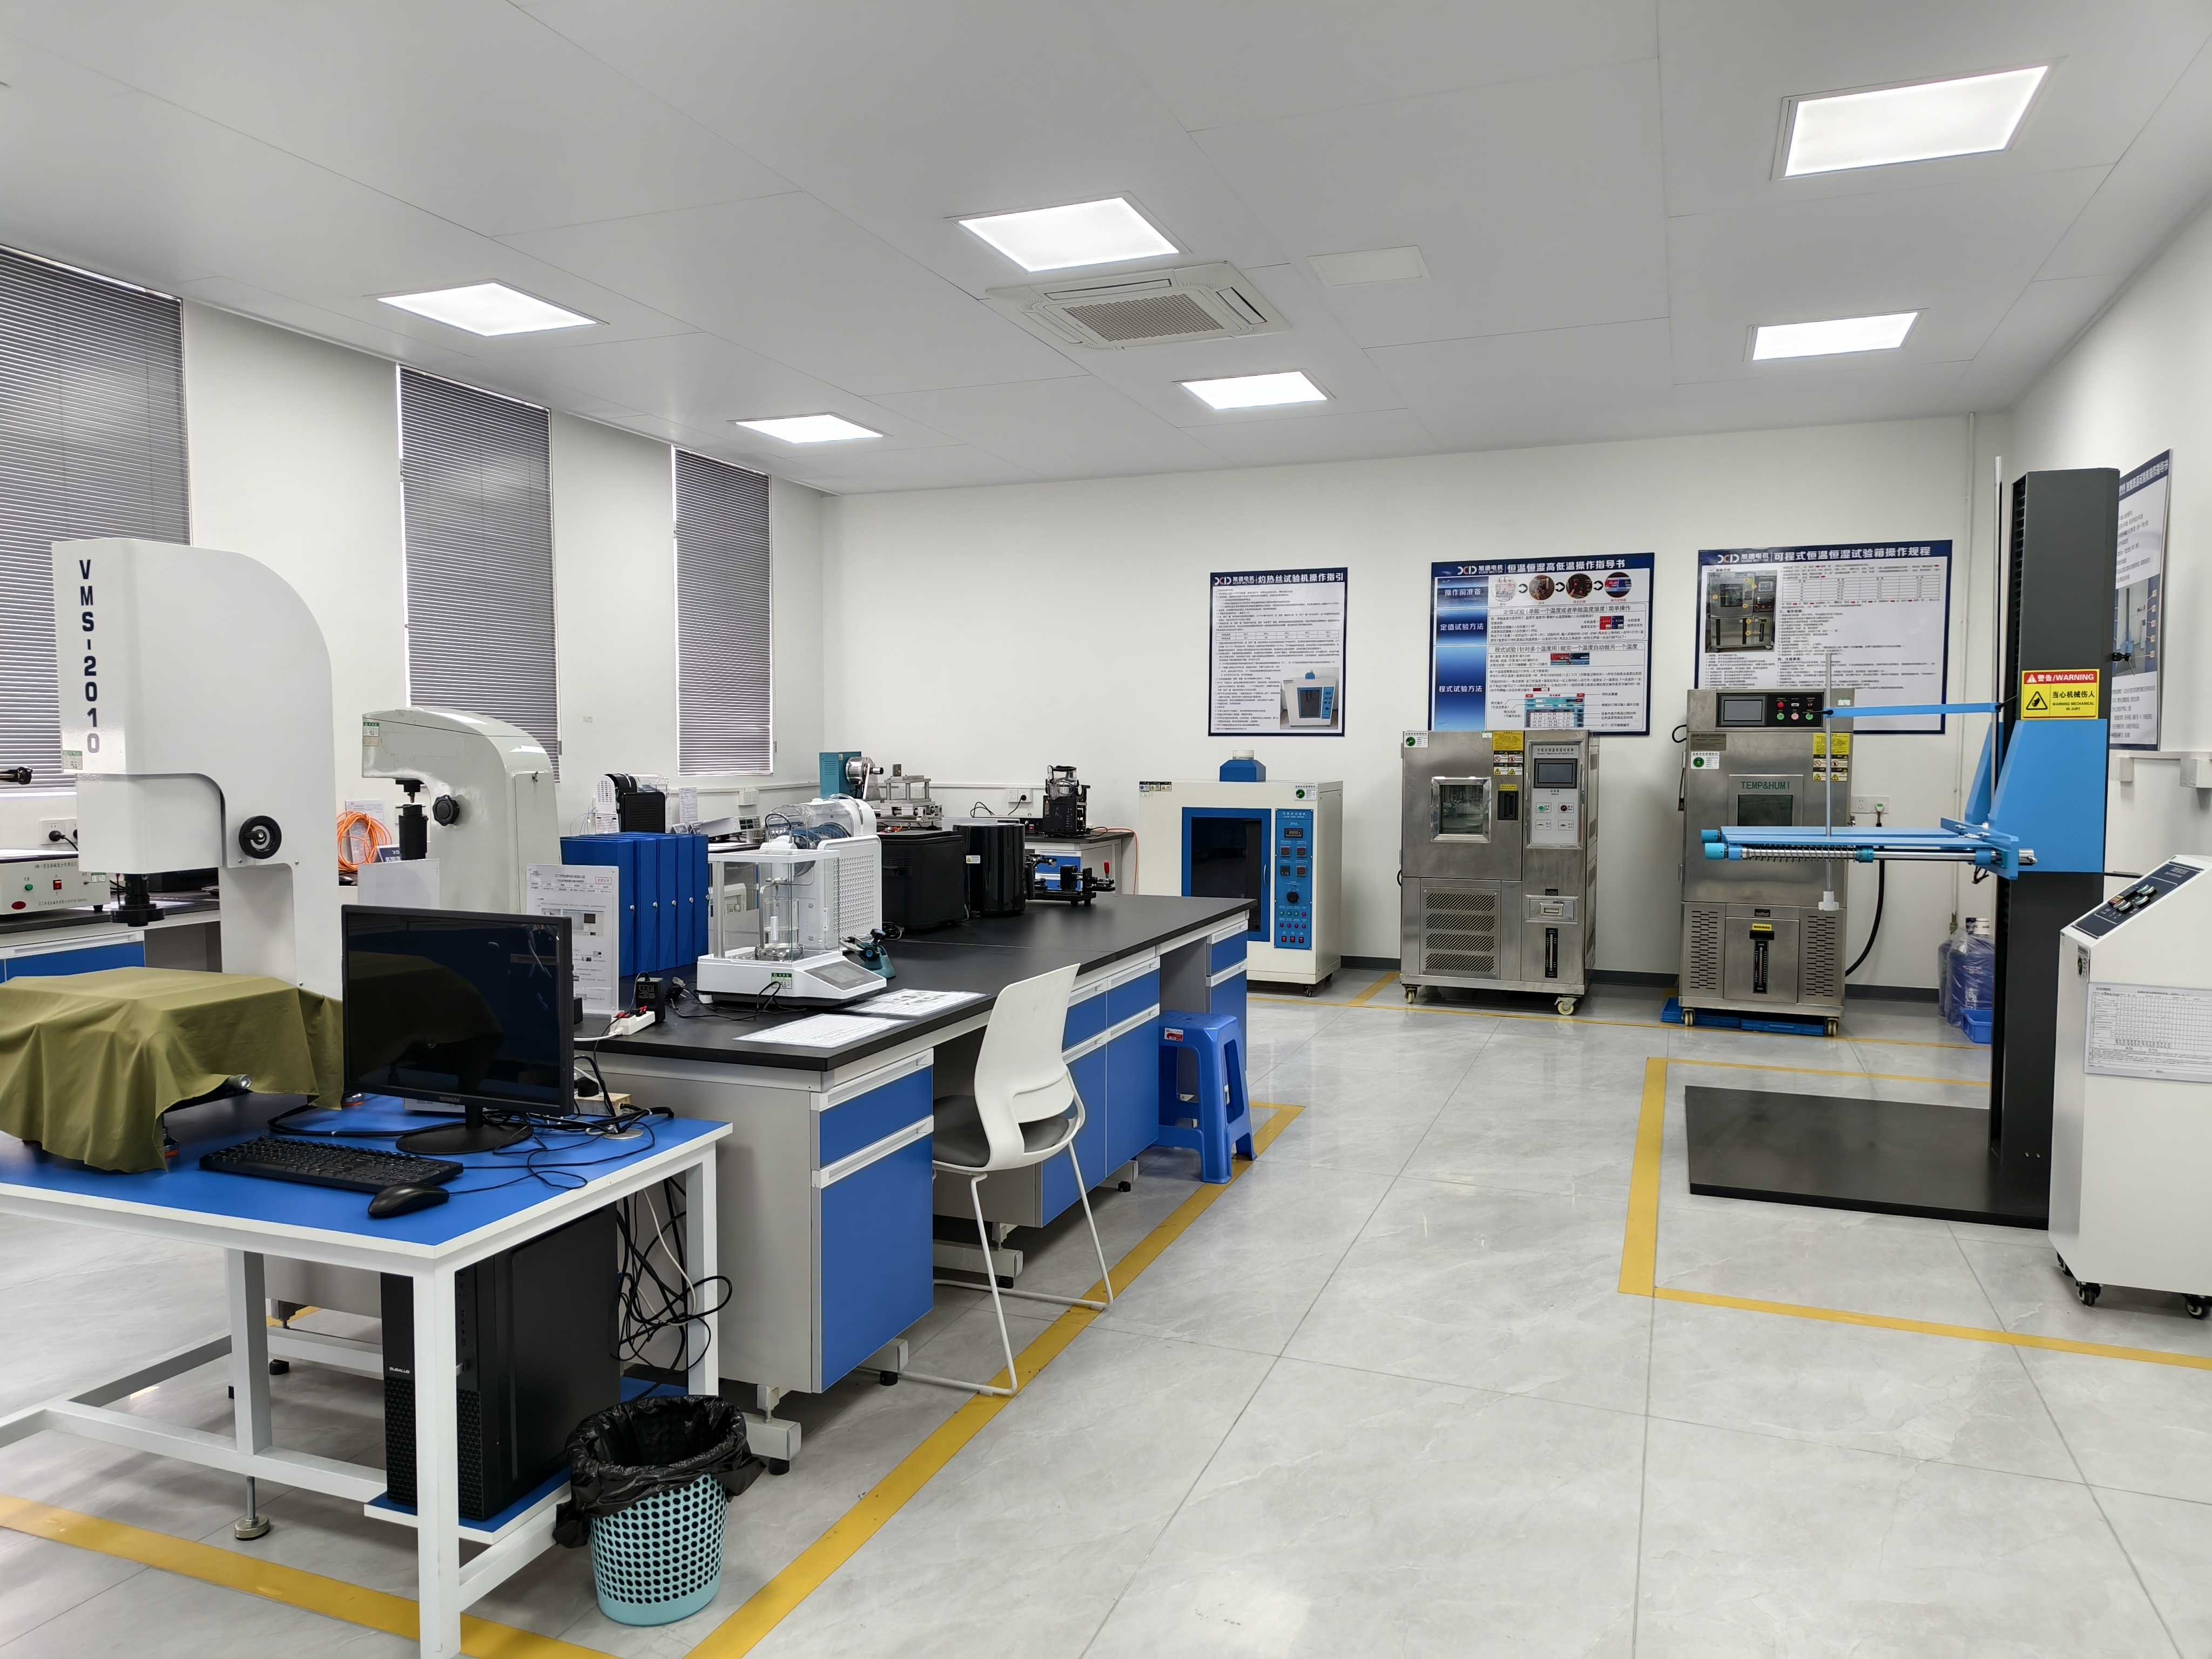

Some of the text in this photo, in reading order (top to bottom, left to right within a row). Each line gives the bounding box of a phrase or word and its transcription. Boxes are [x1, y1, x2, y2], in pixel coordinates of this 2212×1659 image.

[1774, 547, 1931, 561] 可程式恒温恒湿试验箱操作规程
[1507, 559, 1626, 573] 恒温恒湿高低温操作指导书
[1258, 572, 1344, 583] 灼热丝试验机操作指引
[1445, 588, 1482, 596] 操作前准备
[79, 559, 100, 753] VMS-2010
[2038, 673, 2094, 683] 警告/WARNING
